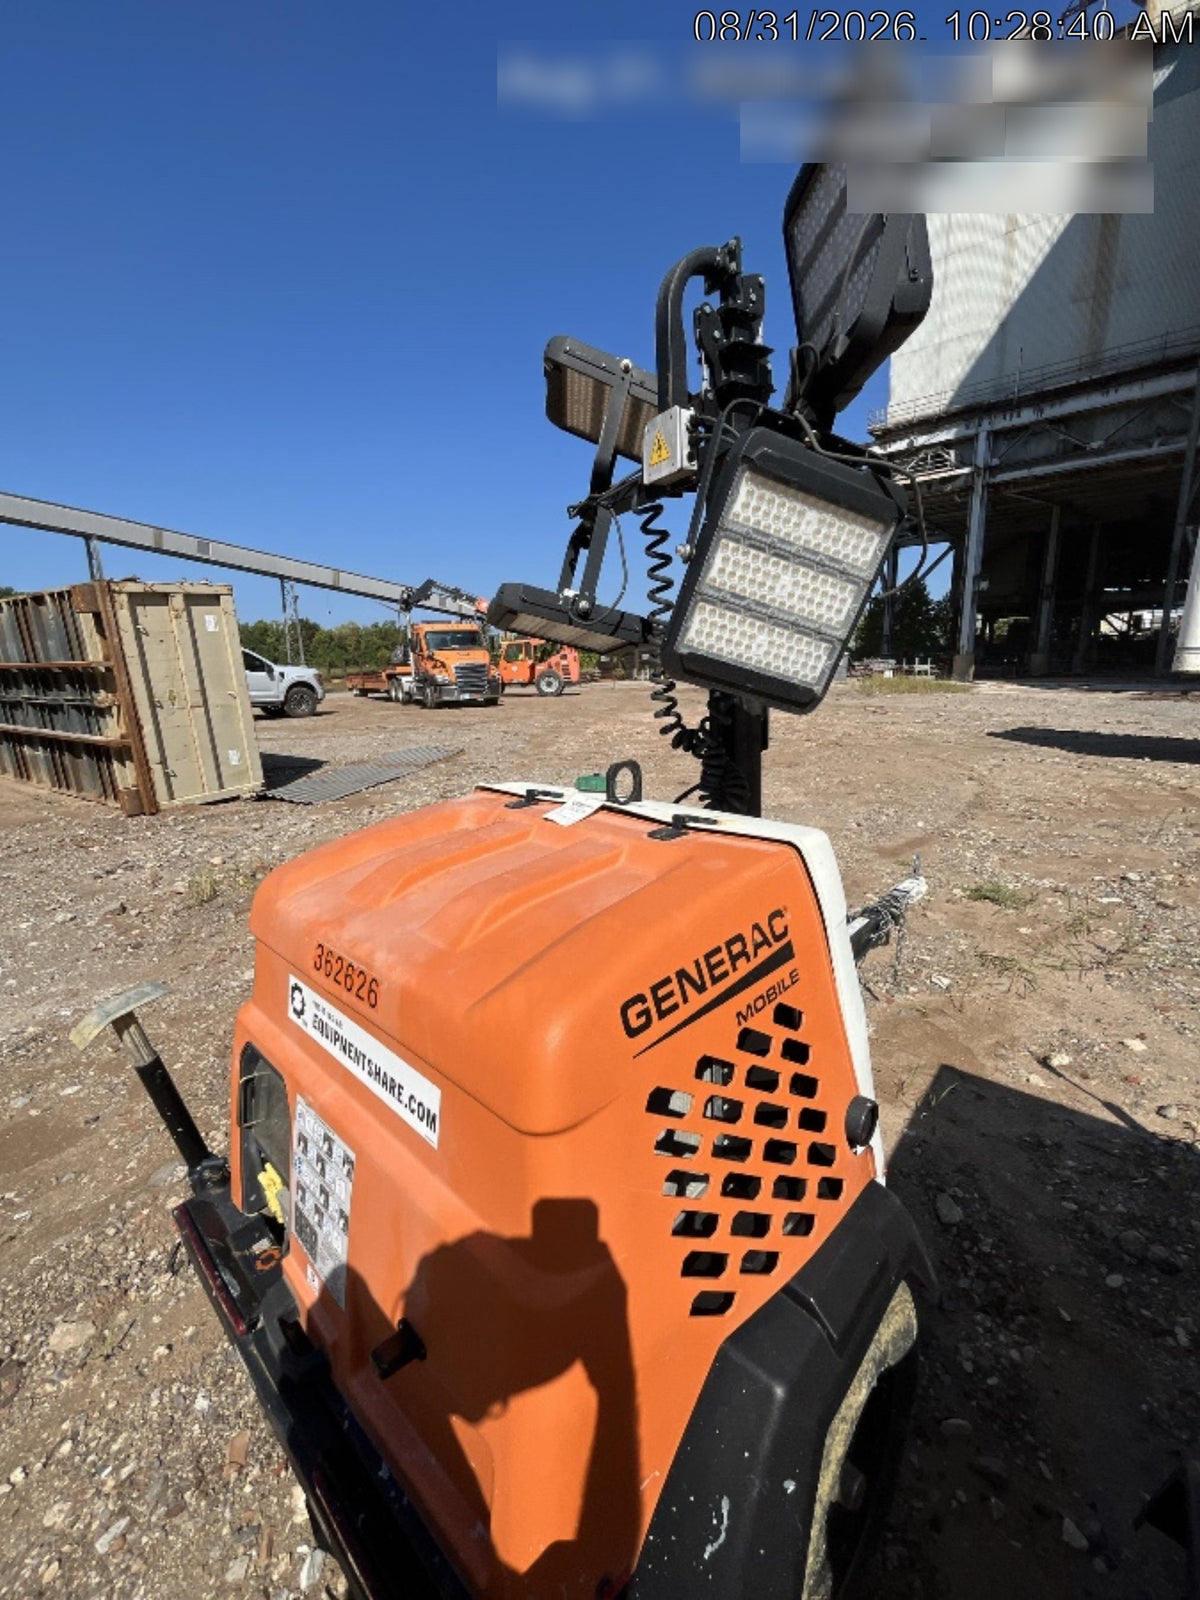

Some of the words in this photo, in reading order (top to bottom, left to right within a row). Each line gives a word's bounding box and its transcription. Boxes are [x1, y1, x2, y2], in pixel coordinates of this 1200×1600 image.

[314, 943, 379, 1009] 362626
[620, 908, 788, 1039] GENERAC
[735, 968, 801, 1026] MOBILE
[312, 1013, 437, 1134] EQUIPMENTSHARE.COM
